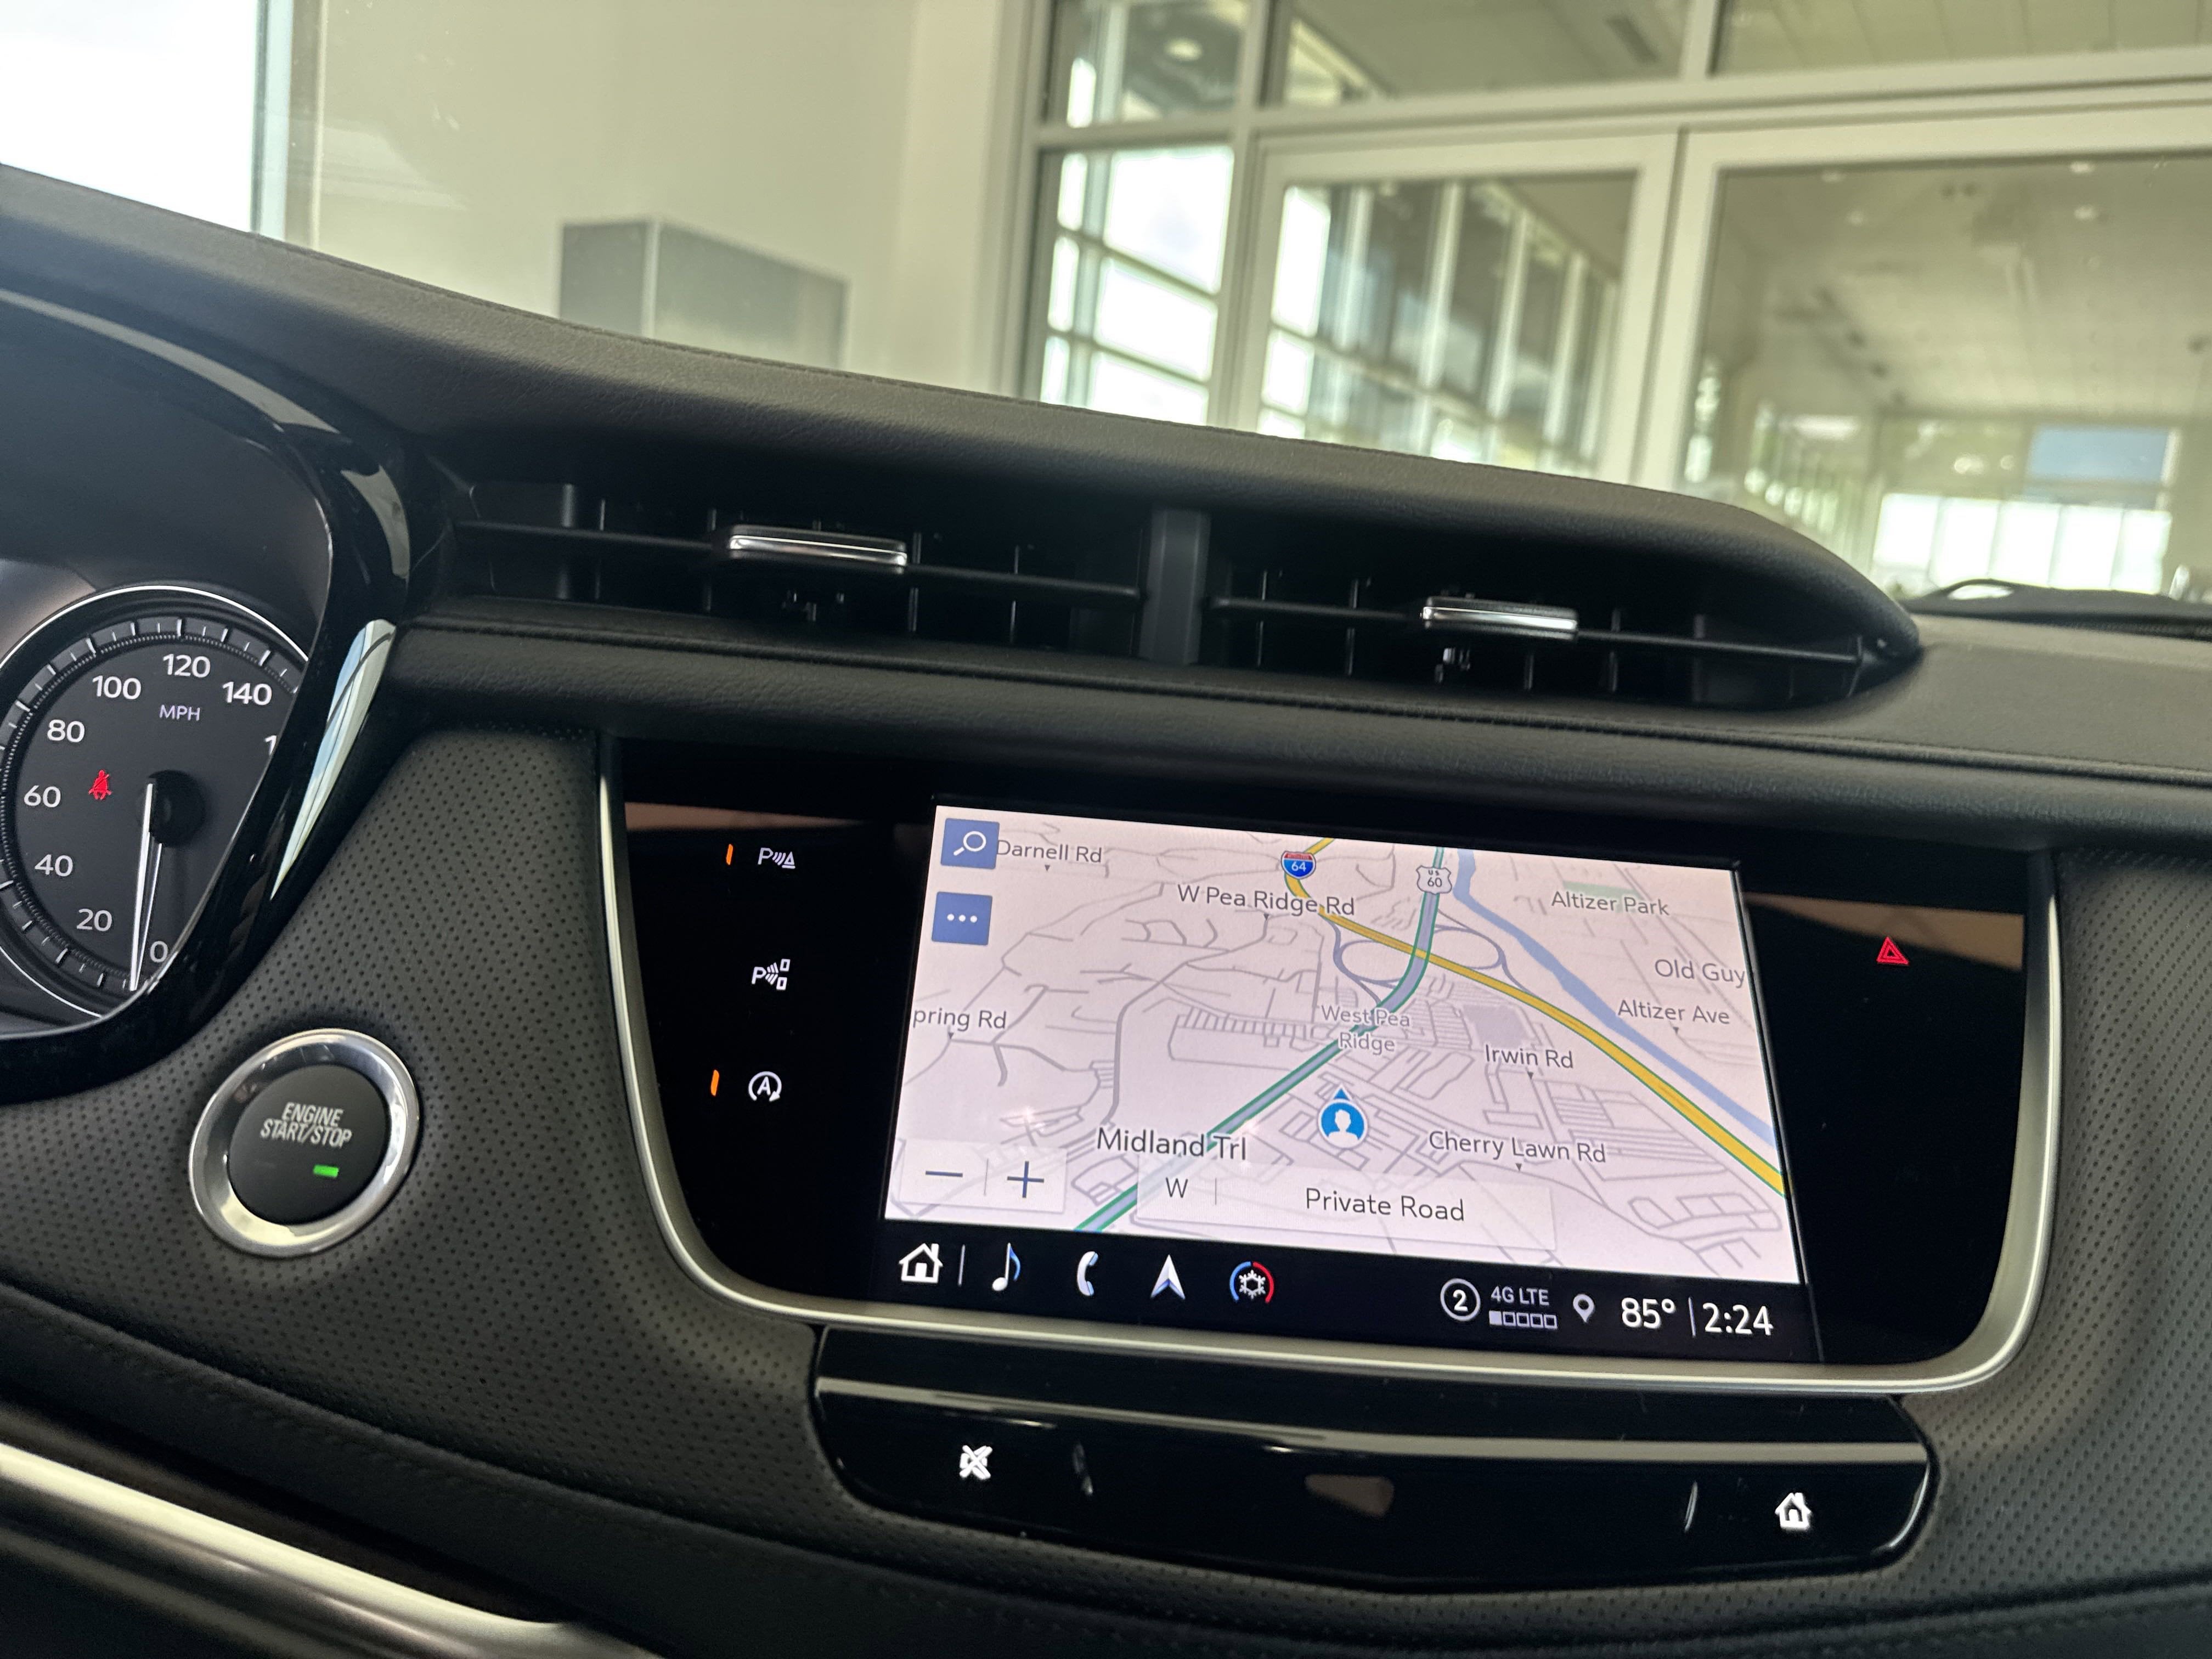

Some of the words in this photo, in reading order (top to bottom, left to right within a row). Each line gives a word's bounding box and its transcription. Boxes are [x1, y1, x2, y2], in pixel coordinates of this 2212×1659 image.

[163, 653, 211, 678] 120
[92, 676, 142, 699] 100
[222, 681, 273, 706] 140
[159, 705, 201, 721] MPH
[47, 720, 85, 743] 80
[24, 785, 61, 808] 60
[997, 839, 1069, 861] Darnell
[1076, 846, 1102, 863] Rd
[35, 854, 73, 877] 40
[1291, 861, 1307, 872] 64
[1427, 877, 1442, 887] 60
[1178, 884, 1200, 903] W
[1206, 887, 1246, 907] Pea
[1254, 890, 1317, 916] Ridge
[1327, 898, 1355, 916] Rd
[1551, 890, 1617, 912] Altizer
[1624, 897, 1669, 916] Park
[76, 909, 112, 932] 20
[150, 940, 168, 963] 0
[1655, 958, 1695, 979] Old
[1702, 963, 1746, 988] Guy
[978, 1009, 1007, 1029] Rd
[1321, 1005, 1370, 1023] West
[1376, 1008, 1410, 1027] Pea
[1617, 999, 1685, 1022] Altizer
[1692, 1005, 1730, 1025] Ave
[1338, 1031, 1395, 1055] Ridge
[1485, 1045, 1538, 1066] Irwin
[1545, 1051, 1573, 1069] Rd
[281, 1102, 343, 1127] ENGINE
[259, 1119, 352, 1148] START/STOP
[1097, 1127, 1205, 1158] Midland
[1214, 1136, 1247, 1161] Trl
[1429, 1131, 1503, 1160] Cherry
[1511, 1137, 1570, 1161] Lawn
[1578, 1144, 1606, 1164] Rd
[1166, 1177, 1188, 1199] W
[1306, 1188, 1392, 1216] Private
[1401, 1195, 1465, 1222] Road
[1452, 1291, 1469, 1312] 2
[1491, 1287, 1514, 1304] 4G
[1519, 1289, 1549, 1307] LTE
[1621, 1297, 1675, 1330] 85°
[1703, 1302, 1774, 1336] 2:24
